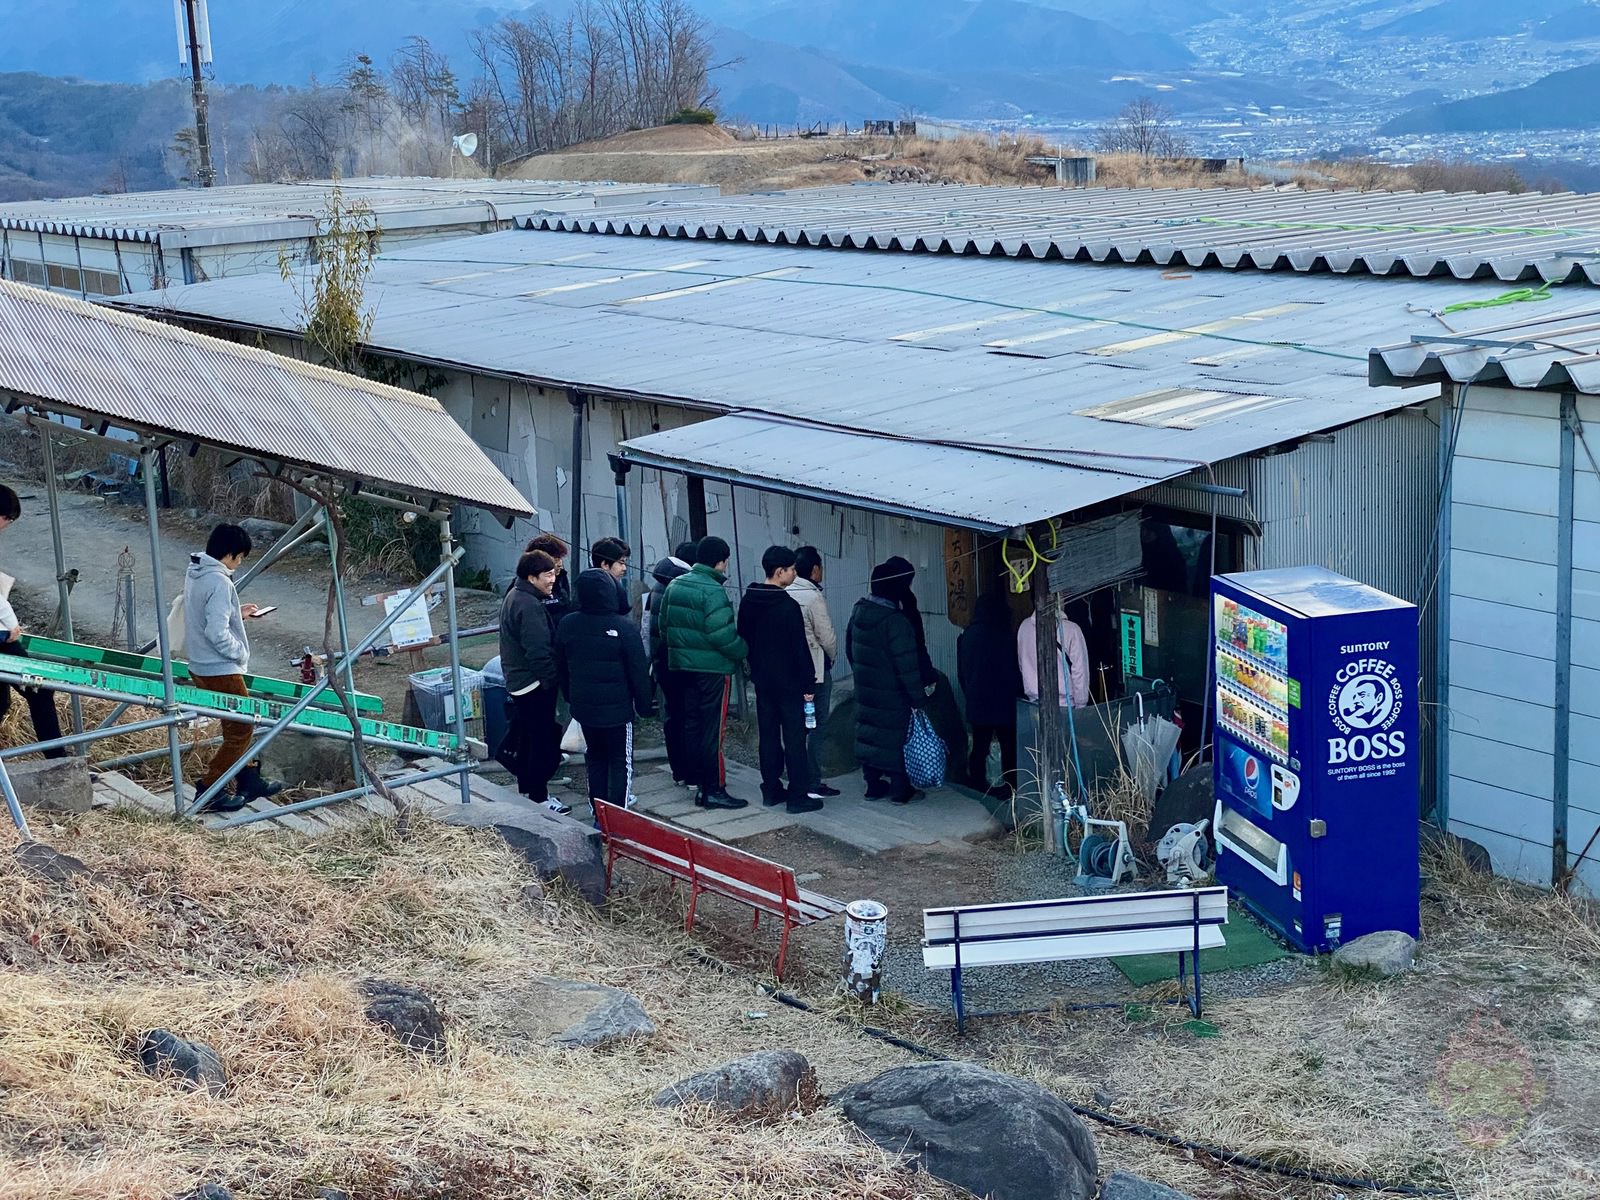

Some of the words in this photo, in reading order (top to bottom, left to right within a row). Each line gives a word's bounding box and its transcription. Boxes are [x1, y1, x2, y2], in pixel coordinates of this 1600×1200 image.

[1340, 640, 1390, 654] SUNTORY
[1336, 658, 1396, 683] COFFEE
[1390, 677, 1403, 699] BOSS
[1328, 683, 1341, 717] COFFEE
[1332, 716, 1351, 735] BOSS
[1380, 700, 1403, 731] COFFEE
[1328, 730, 1406, 764] BOSS
[1328, 766, 1357, 776] SUNTORY
[1358, 764, 1376, 772] BOSS
